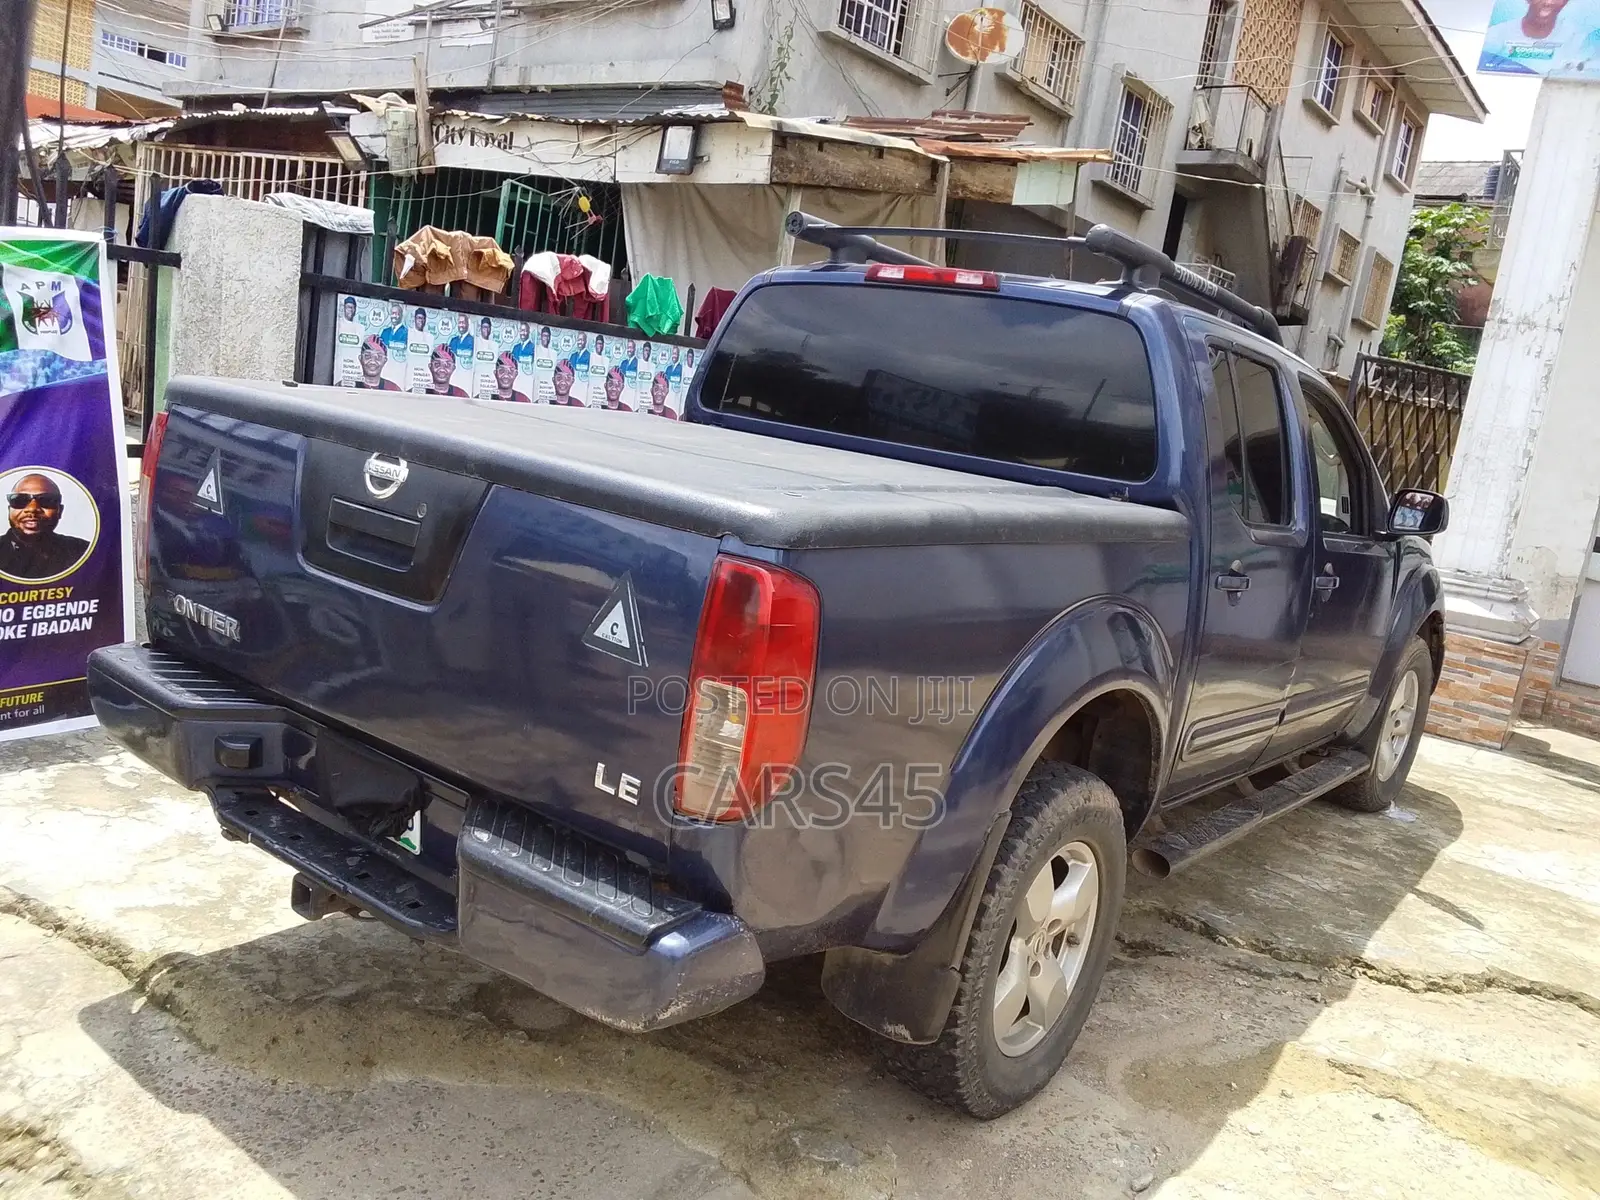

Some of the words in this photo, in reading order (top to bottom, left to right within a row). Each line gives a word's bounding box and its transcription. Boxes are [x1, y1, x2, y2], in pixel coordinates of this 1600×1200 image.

[435, 124, 467, 146] City
[0, 586, 74, 605] COURTESY
[0, 608, 15, 623] O
[22, 599, 100, 621] EGBENDE
[31, 616, 93, 637] IBADAN
[610, 621, 619, 636] C
[0, 692, 45, 708] FUTURE
[14, 708, 30, 719] for
[33, 704, 45, 715] all
[594, 761, 642, 806] LE
